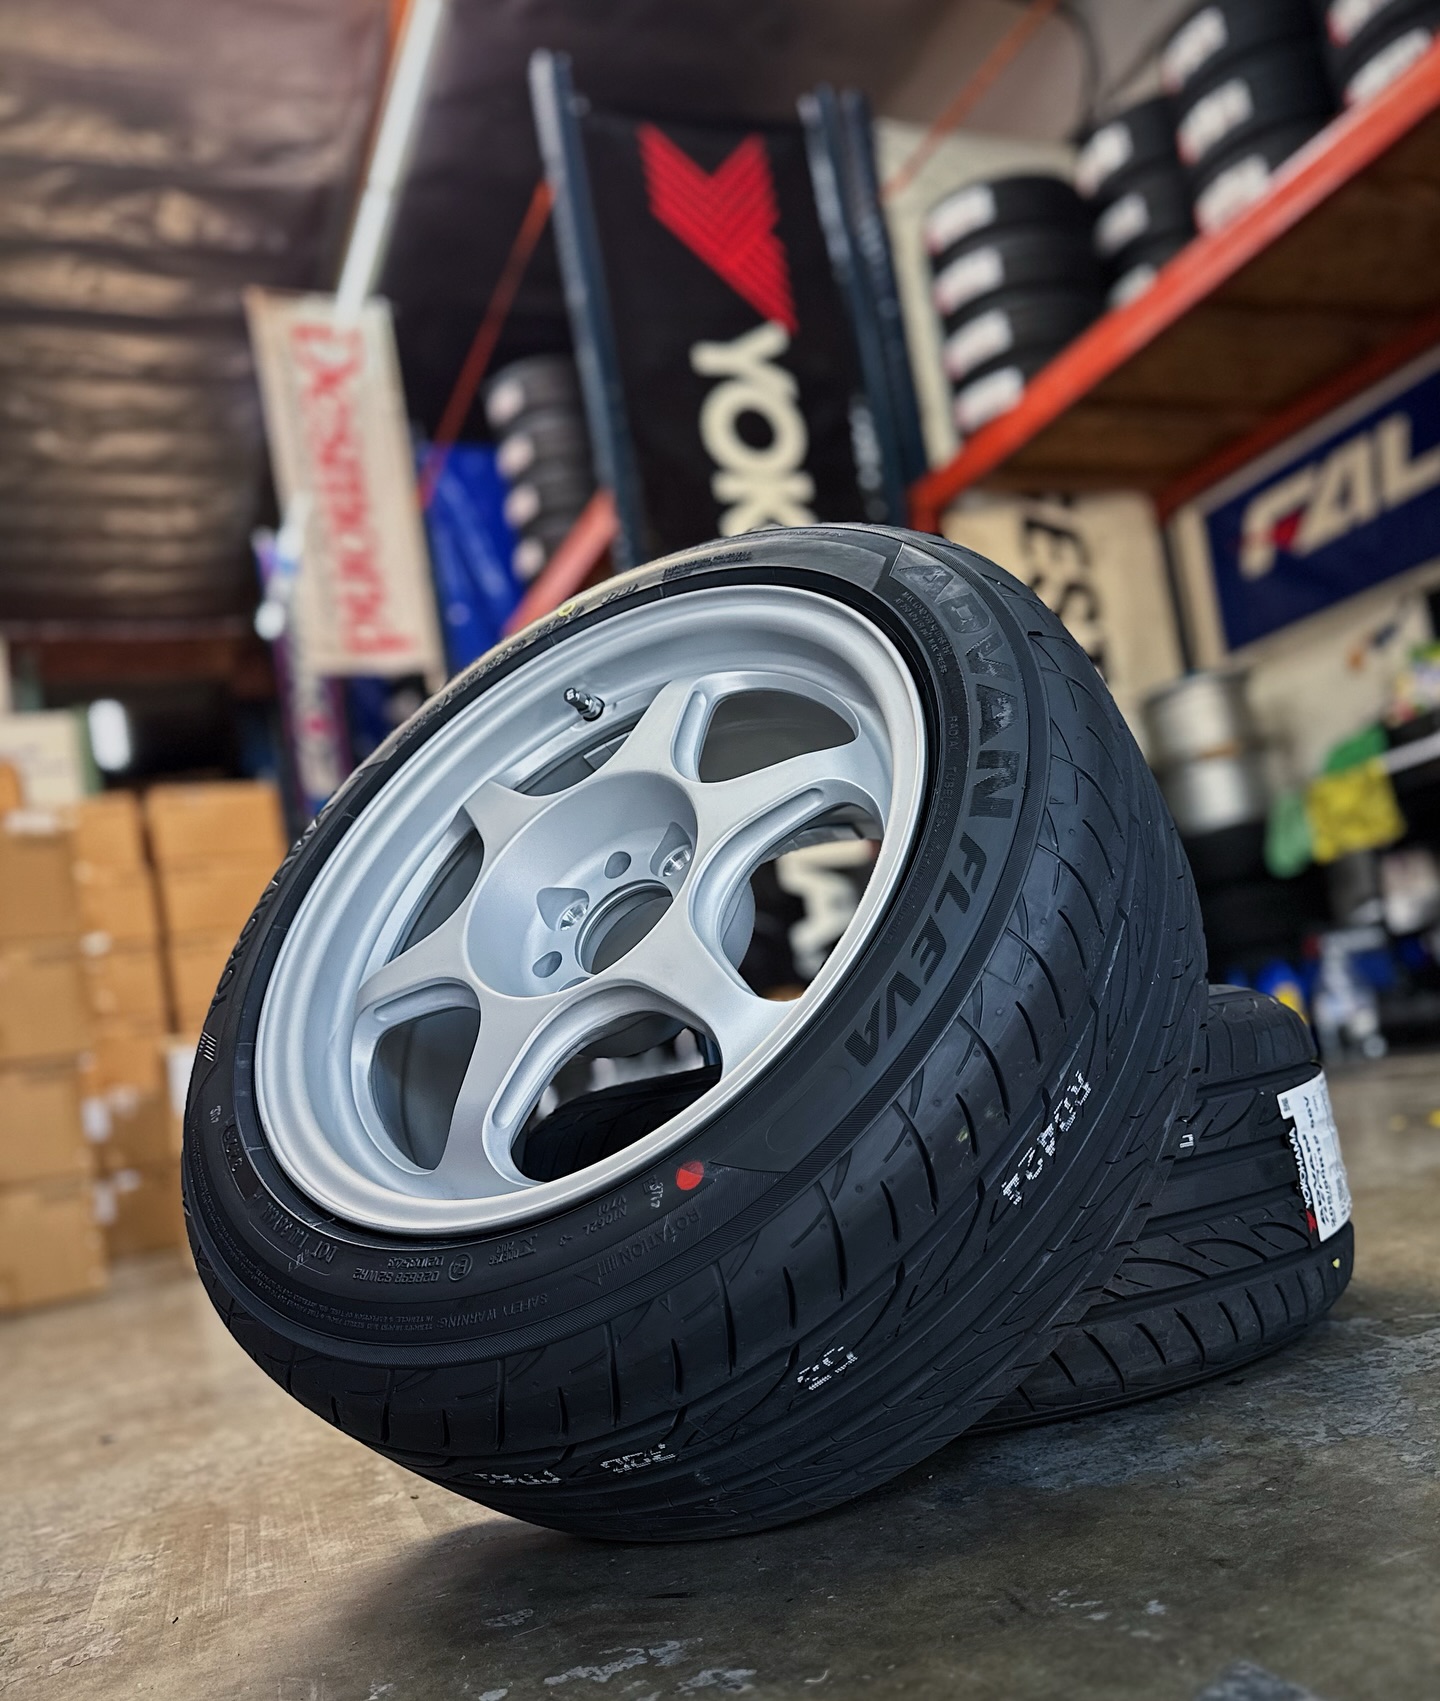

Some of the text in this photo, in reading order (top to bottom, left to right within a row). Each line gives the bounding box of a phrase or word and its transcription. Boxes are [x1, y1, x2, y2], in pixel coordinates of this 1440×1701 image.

[896, 563, 1021, 819] ADVAN
[844, 832, 987, 1068] FLEVA
[1288, 1126, 1312, 1209] YOKOHAMA
[616, 1208, 701, 1267] ROTATION
[502, 1292, 548, 1316] SAFETY
